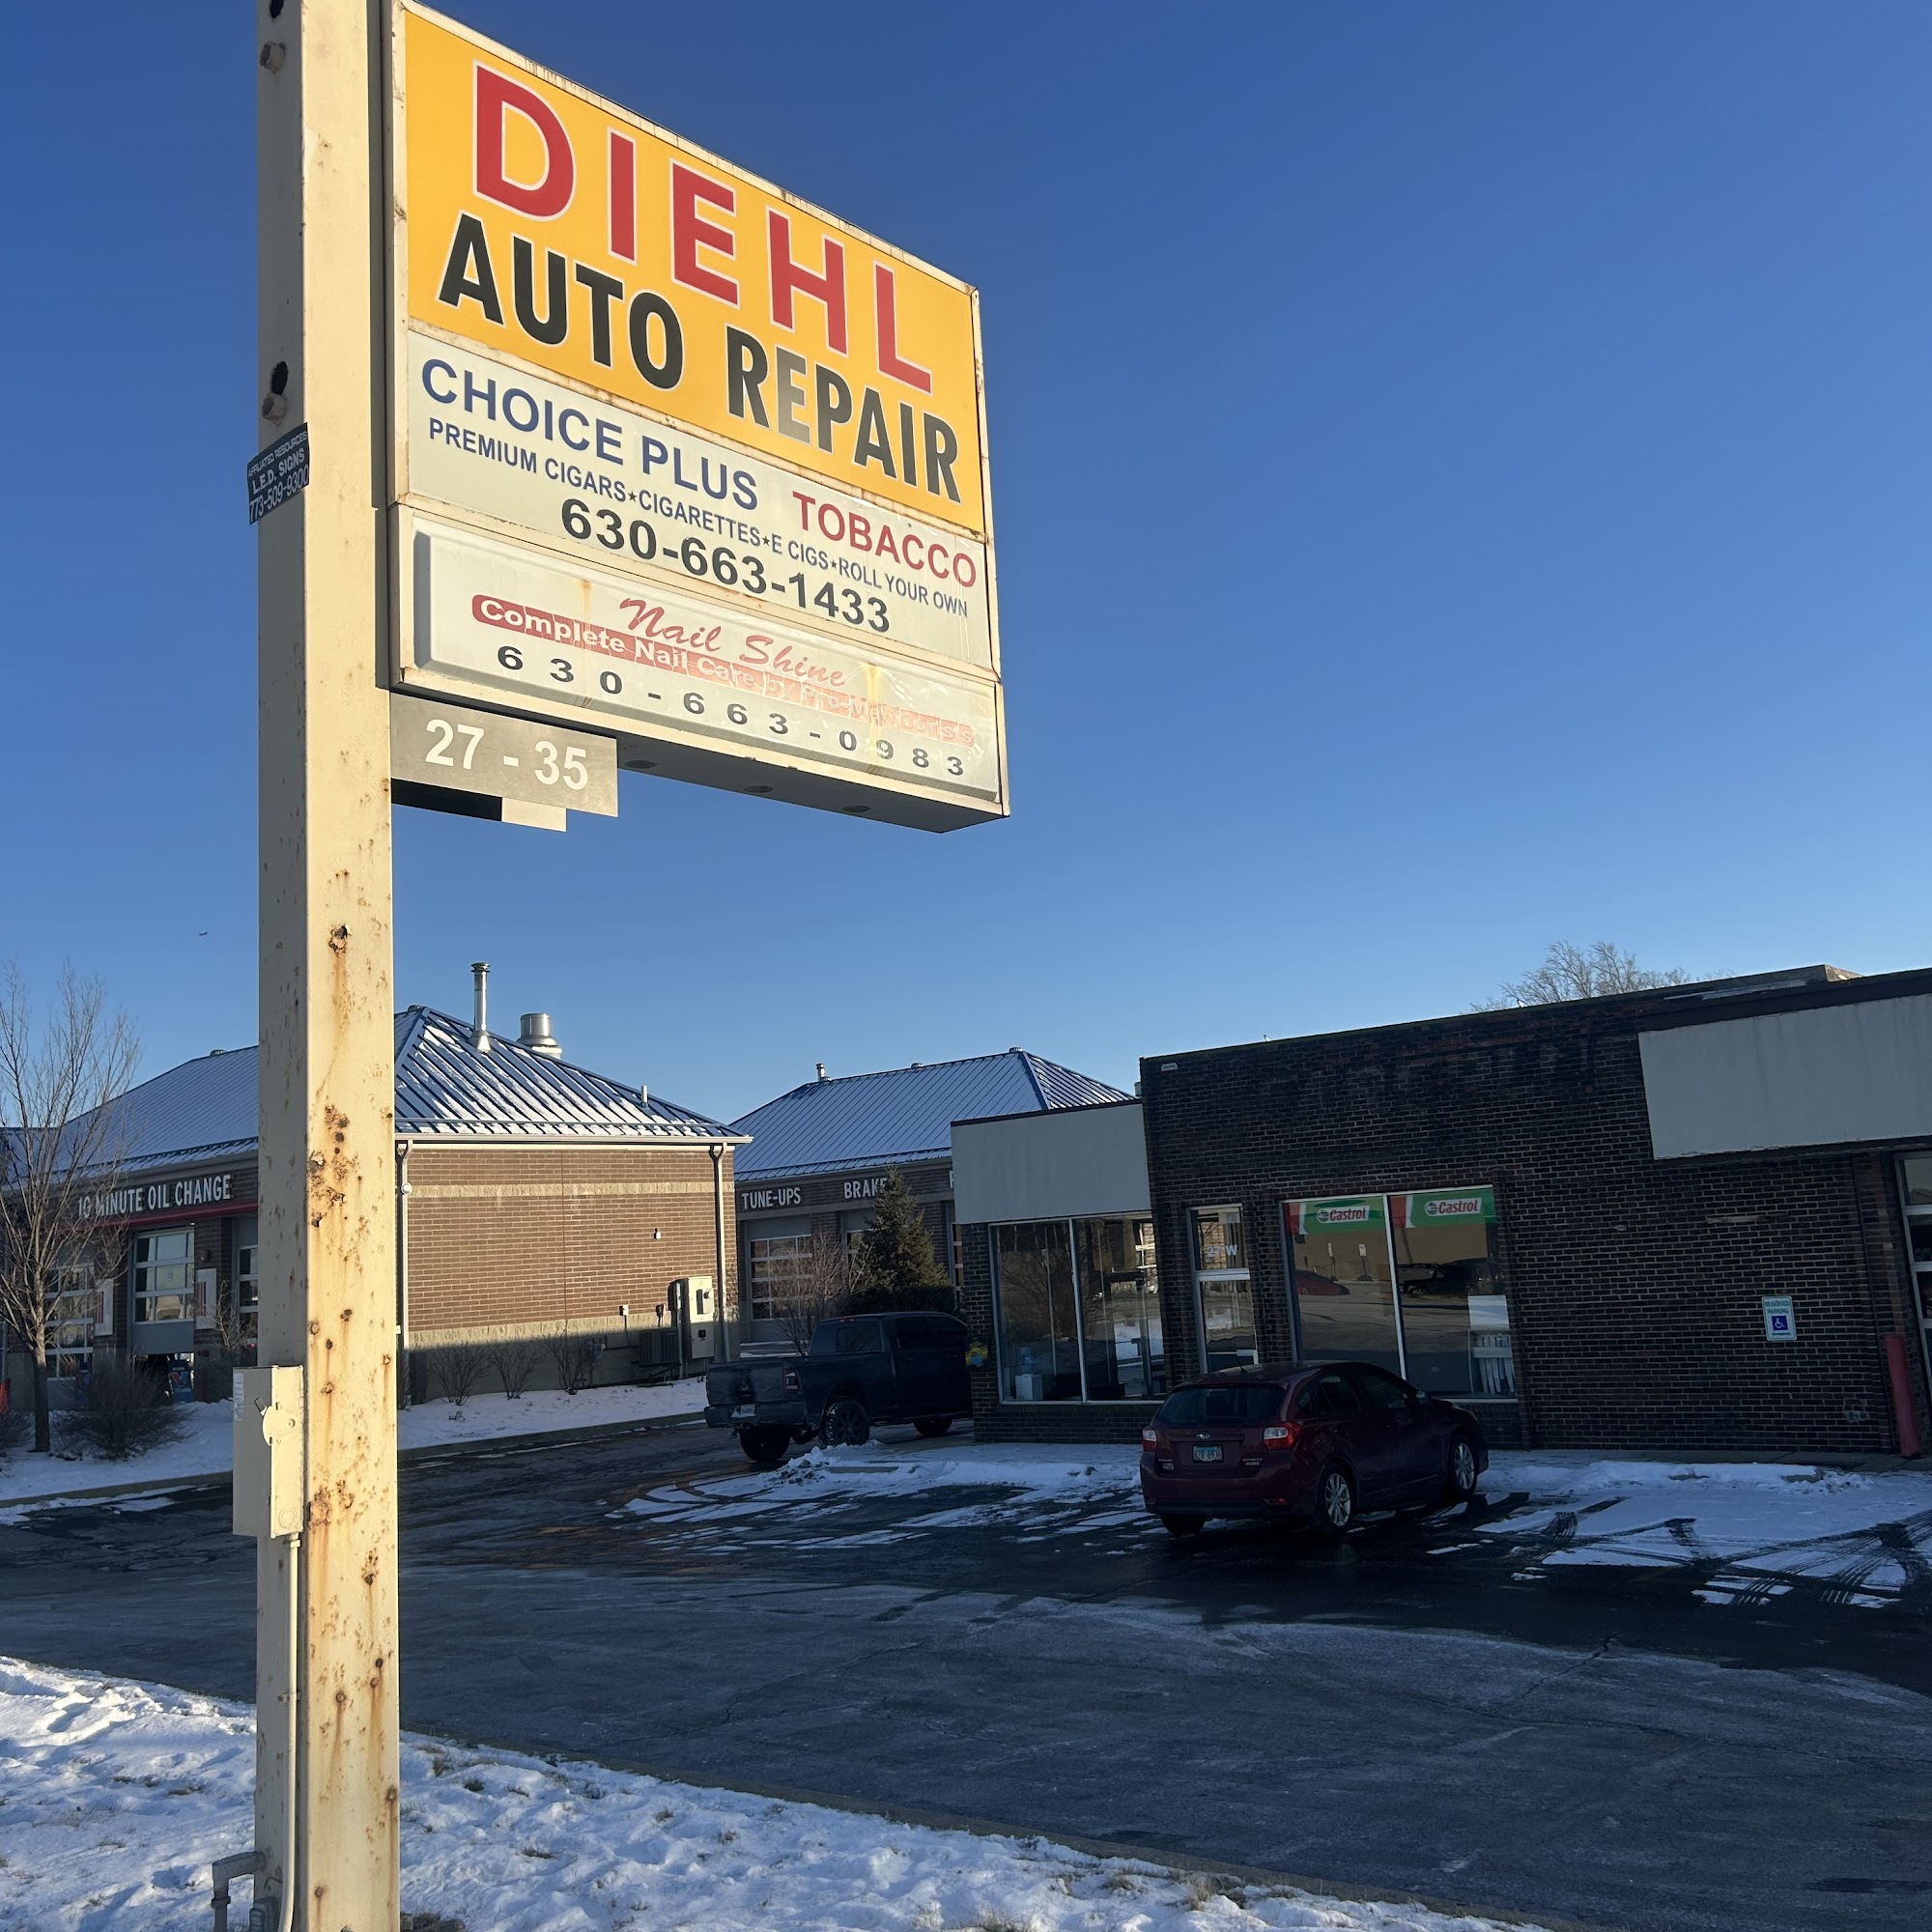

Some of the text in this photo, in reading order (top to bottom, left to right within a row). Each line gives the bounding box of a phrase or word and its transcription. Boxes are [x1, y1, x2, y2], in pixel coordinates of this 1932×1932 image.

[474, 61, 933, 395] DIEHL
[438, 212, 962, 504] AUTO REPAIR
[250, 464, 308, 523] 773-509-9300
[253, 447, 305, 495] L.E.D. SIGNS
[422, 358, 977, 587] CHOICE PLUS TOBACCO
[430, 417, 537, 473] PREMIUM
[885, 573, 929, 606] YOUR
[933, 592, 968, 618] OWN
[561, 498, 890, 633] 630-663-1433
[480, 599, 625, 653] Complete
[635, 641, 688, 669] Nail
[696, 656, 756, 688] Care
[764, 671, 796, 700] by
[619, 598, 846, 687] Nail Shine
[425, 719, 484, 770] 27
[534, 740, 588, 790] 35
[97, 1187, 143, 1216] MINUTE
[148, 1184, 170, 1210] OIL
[175, 1175, 231, 1206] CHANGE
[742, 1187, 801, 1209] TUNE-UPS
[1329, 1207, 1367, 1221] Castrol
[1438, 1199, 1478, 1214] Castrol
[1207, 1244, 1237, 1257] 27 W
